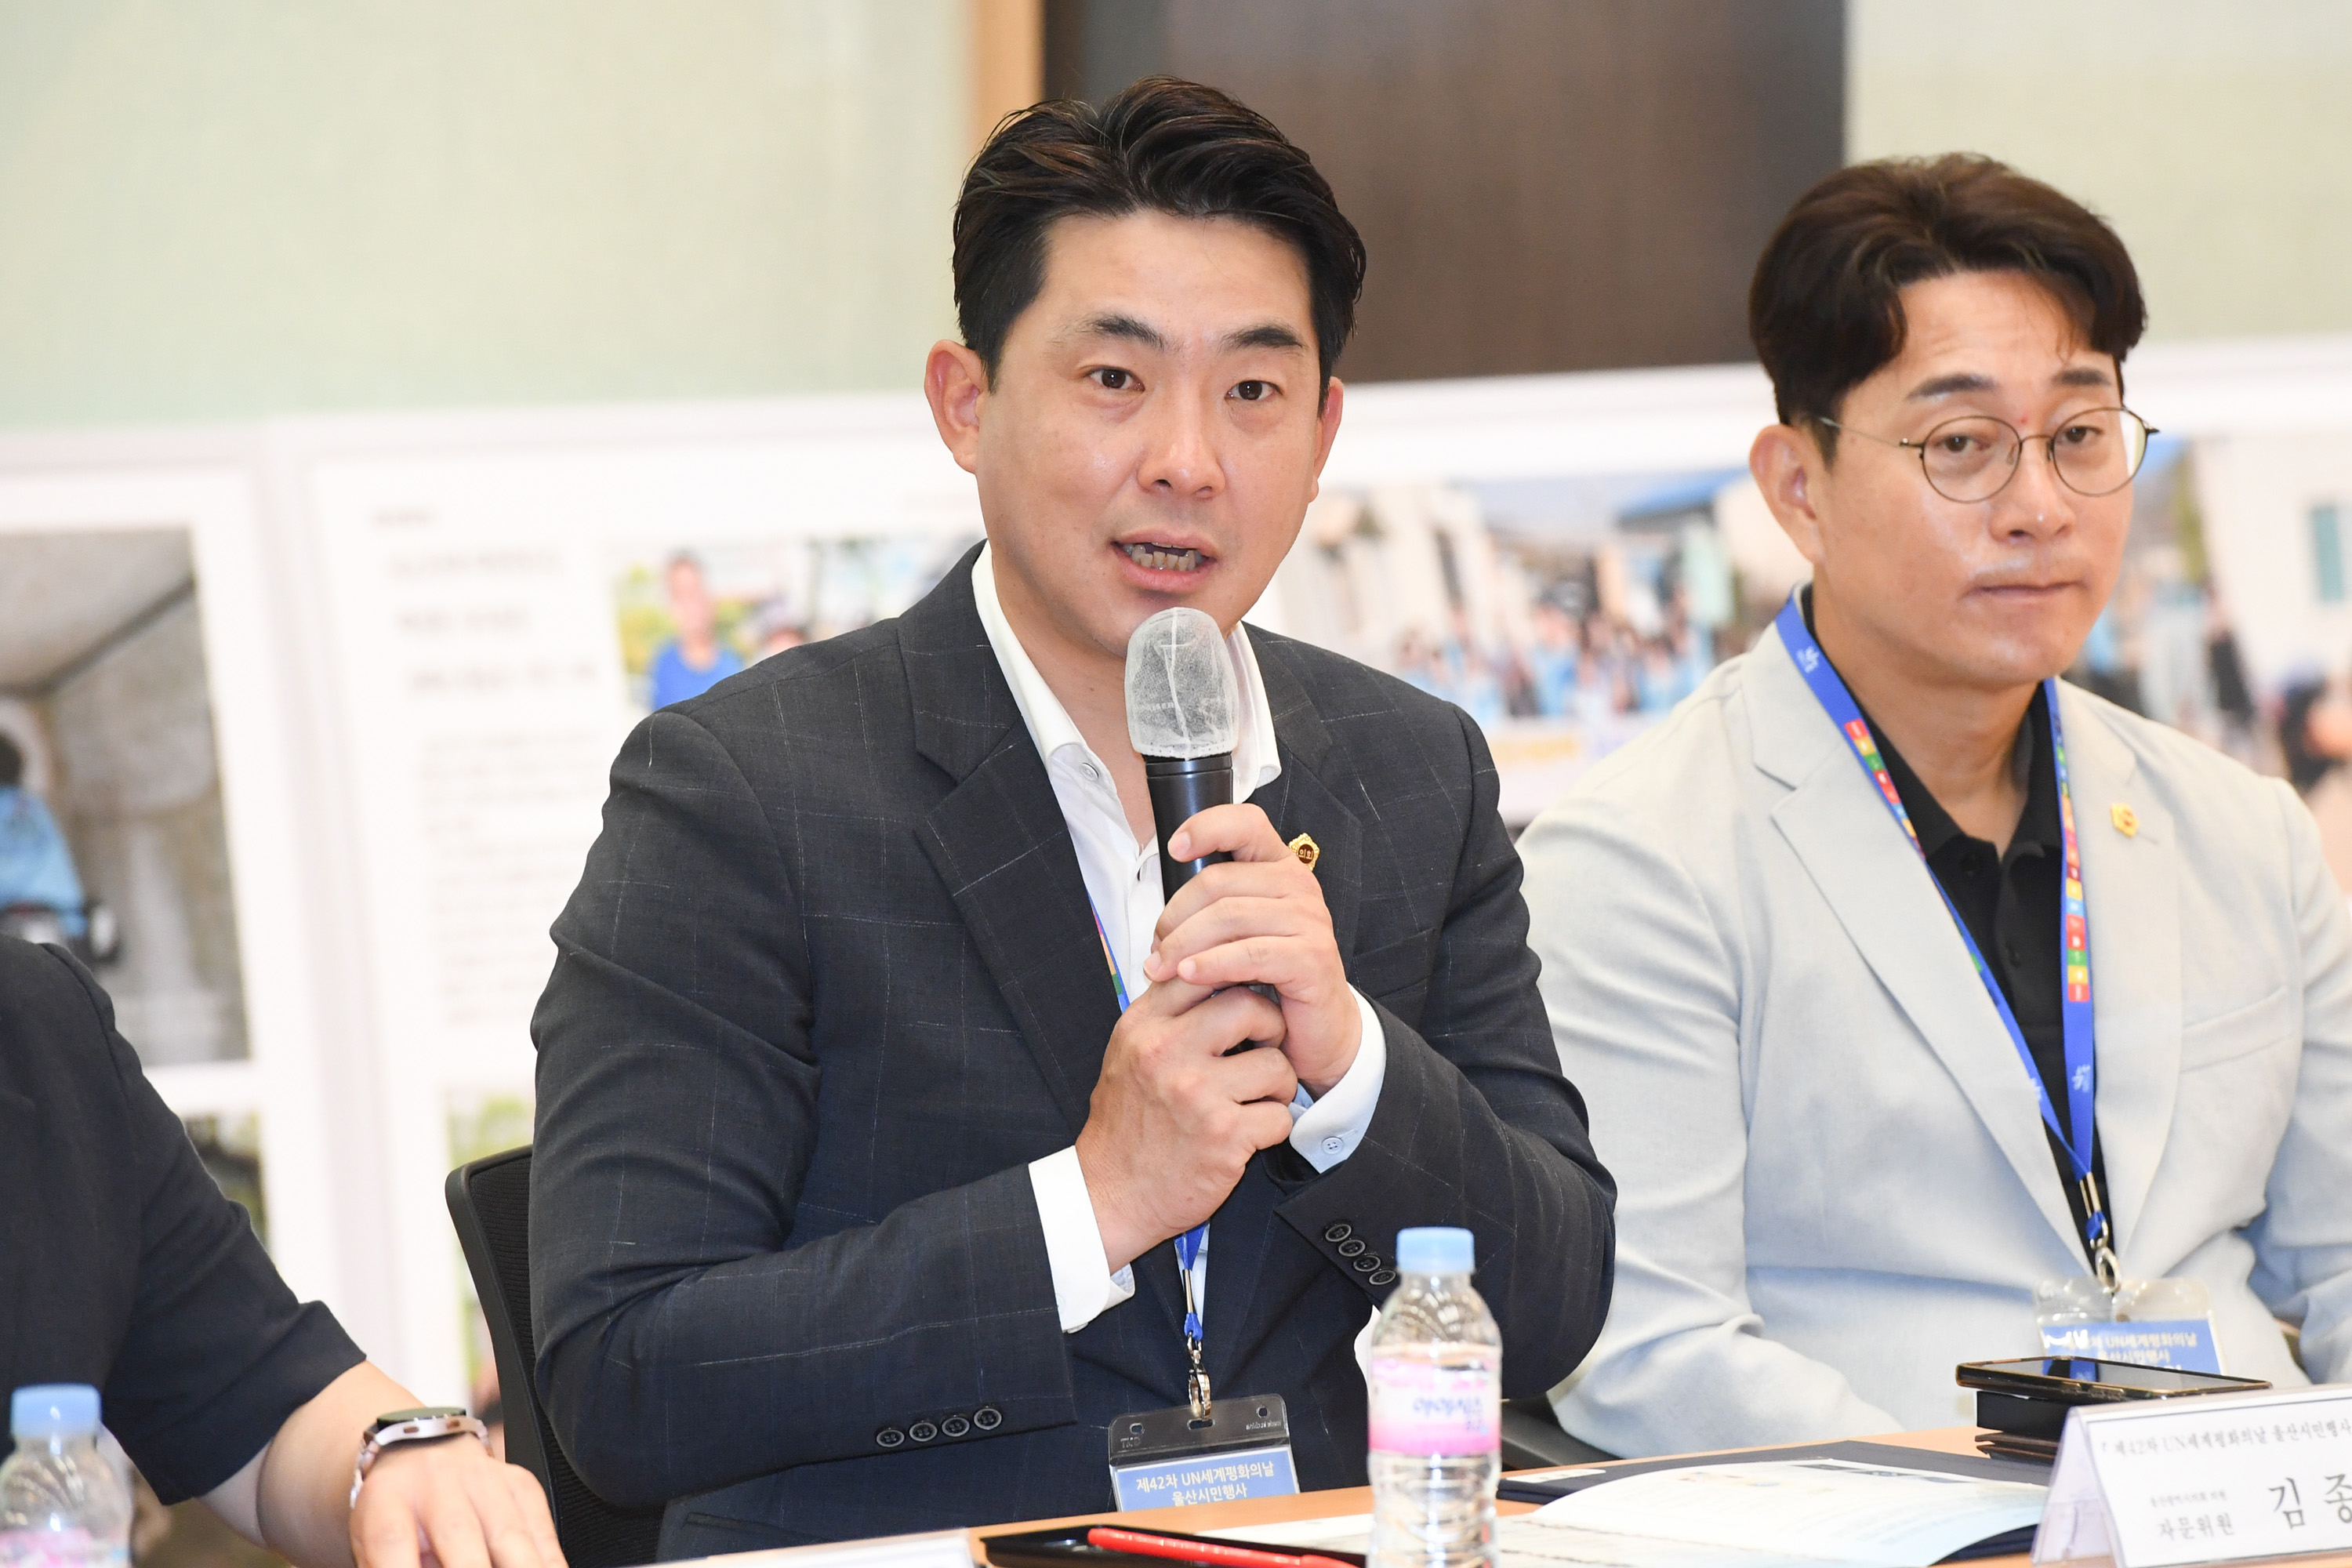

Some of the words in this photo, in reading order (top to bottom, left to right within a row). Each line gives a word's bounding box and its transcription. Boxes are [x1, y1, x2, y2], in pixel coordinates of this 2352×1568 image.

[1298, 848, 1313, 860] 의회
[1136, 1474, 1178, 1493] 제42차
[1181, 1461, 1275, 1486] UN세계평화의날
[1172, 1483, 1247, 1507] 울산시민행사
